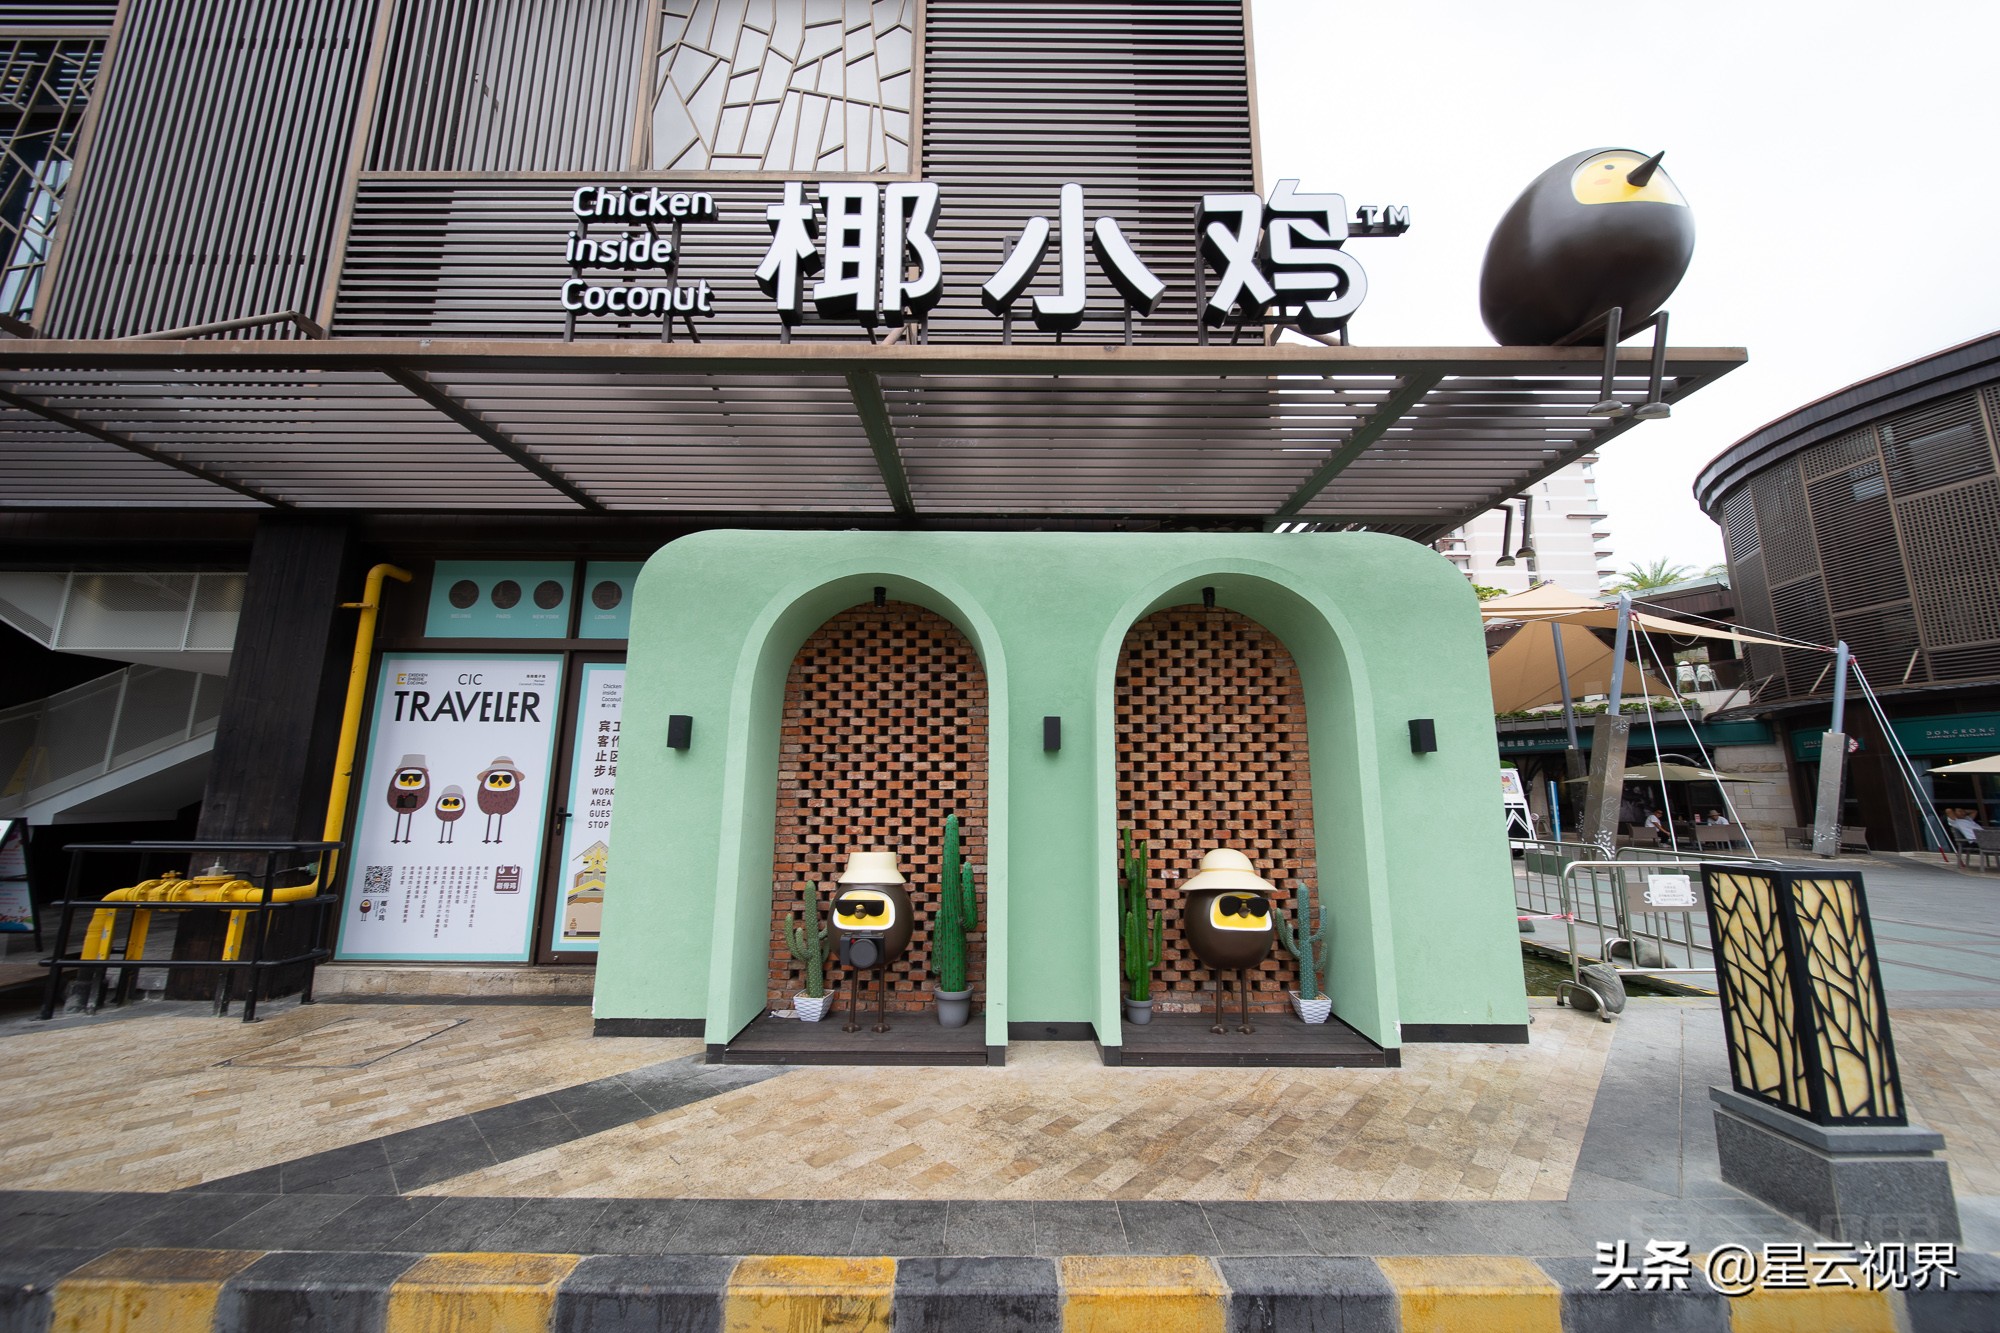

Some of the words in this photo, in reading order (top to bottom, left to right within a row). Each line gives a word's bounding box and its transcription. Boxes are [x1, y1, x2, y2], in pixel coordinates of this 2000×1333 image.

[573, 185, 713, 217] Chicken
[566, 231, 673, 263] inside
[754, 178, 1368, 332] 椰小鸡
[561, 278, 711, 311] Coconut
[457, 673, 483, 686] CIC
[394, 690, 541, 722] TRAVELER
[594, 720, 610, 778] 宾客止步
[590, 798, 612, 807] AREA
[591, 787, 615, 796] WORK
[588, 821, 609, 829] STOP
[589, 809, 613, 818] GUES
